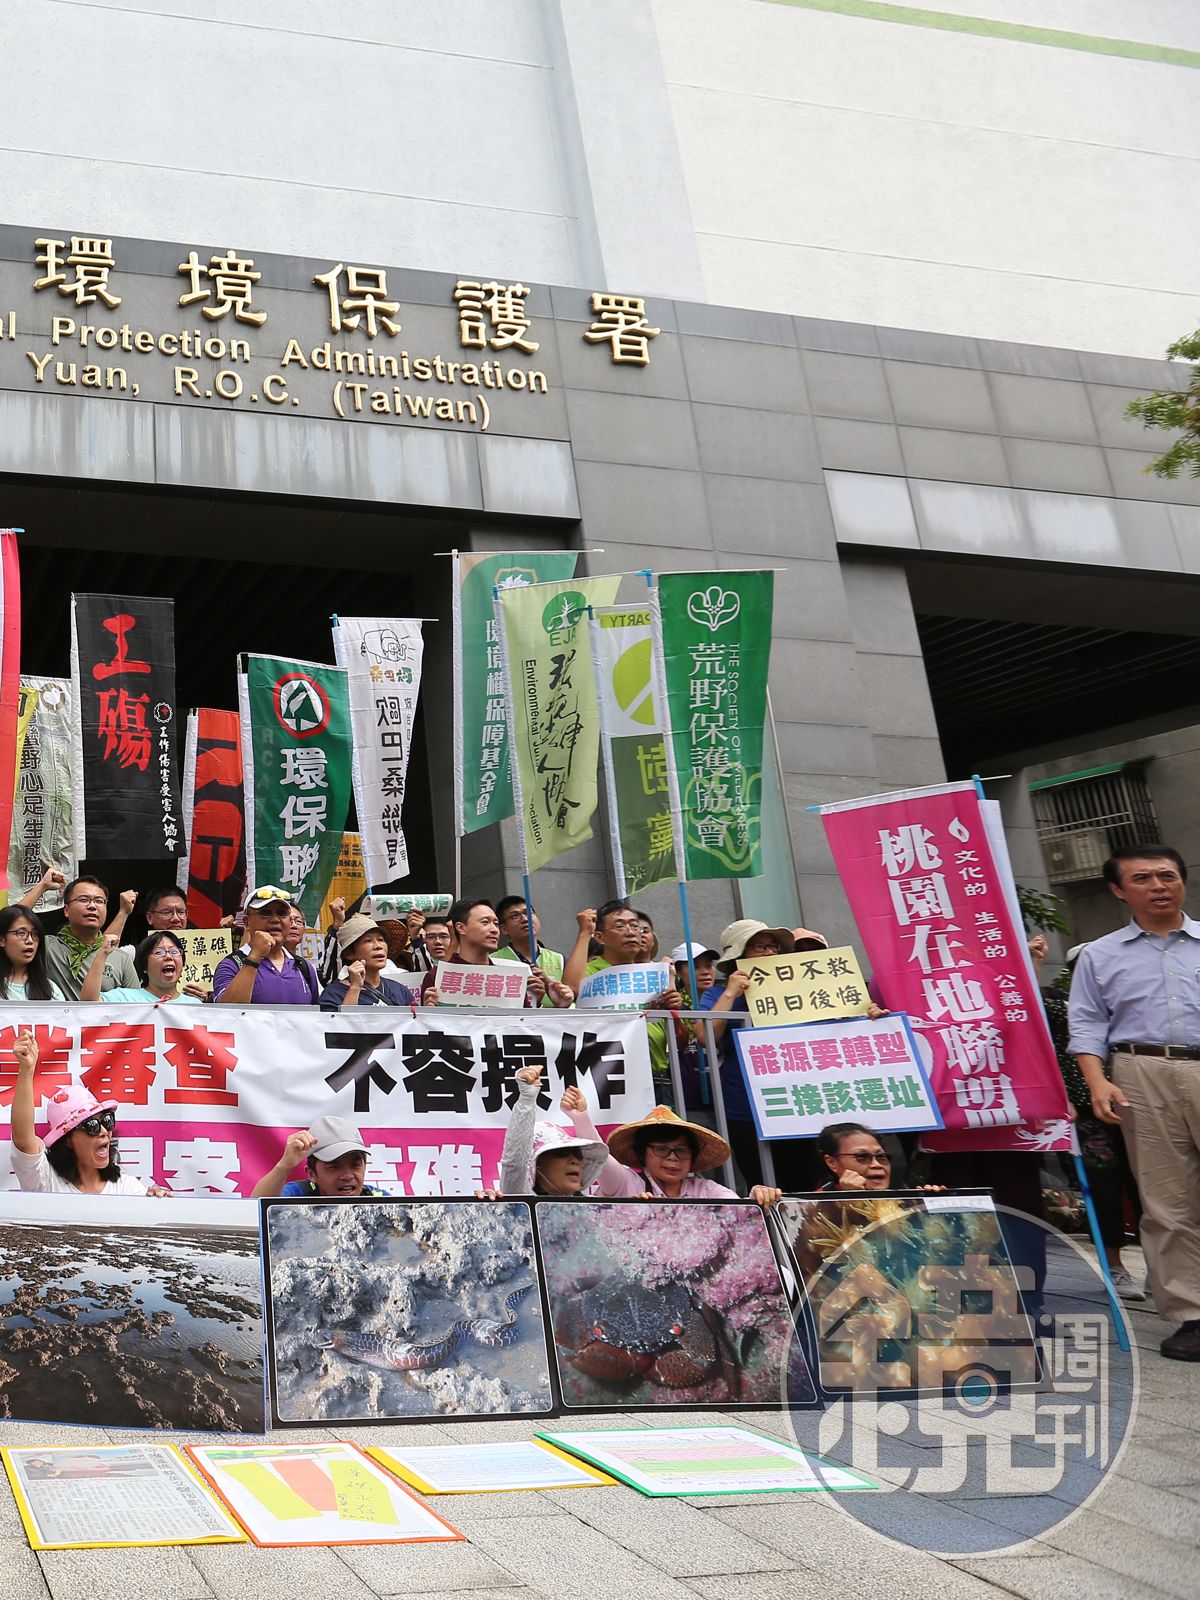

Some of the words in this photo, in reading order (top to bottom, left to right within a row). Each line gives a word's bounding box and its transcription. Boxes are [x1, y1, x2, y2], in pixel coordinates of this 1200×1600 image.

[51, 315, 252, 363] Protection
[282, 338, 549, 394] Administration
[26, 351, 141, 398] Yuan,
[175, 366, 300, 406] R.O.C.
[332, 381, 491, 430] (Taiwan)
[728, 643, 740, 667] THE
[728, 672, 740, 731] SOCIETY
[688, 643, 734, 848] 荒野保護協會
[730, 735, 741, 755] OF
[19, 712, 47, 906] 蠻野心足生態協
[279, 747, 328, 904] 環保聯
[375, 895, 450, 916] 不容操作
[954, 850, 988, 897] 文化的
[974, 911, 1008, 958] 生活的
[994, 974, 1029, 1024] 公義的
[440, 970, 524, 999] 專業審查
[747, 957, 855, 988] 今日不救
[755, 987, 863, 1017] 明日後悔
[877, 825, 1021, 1130] 桃園在地聯盟
[324, 1031, 626, 1115] 不容操作
[749, 1030, 913, 1076] 能源要轉型
[760, 1075, 926, 1118] 三接該遷址
